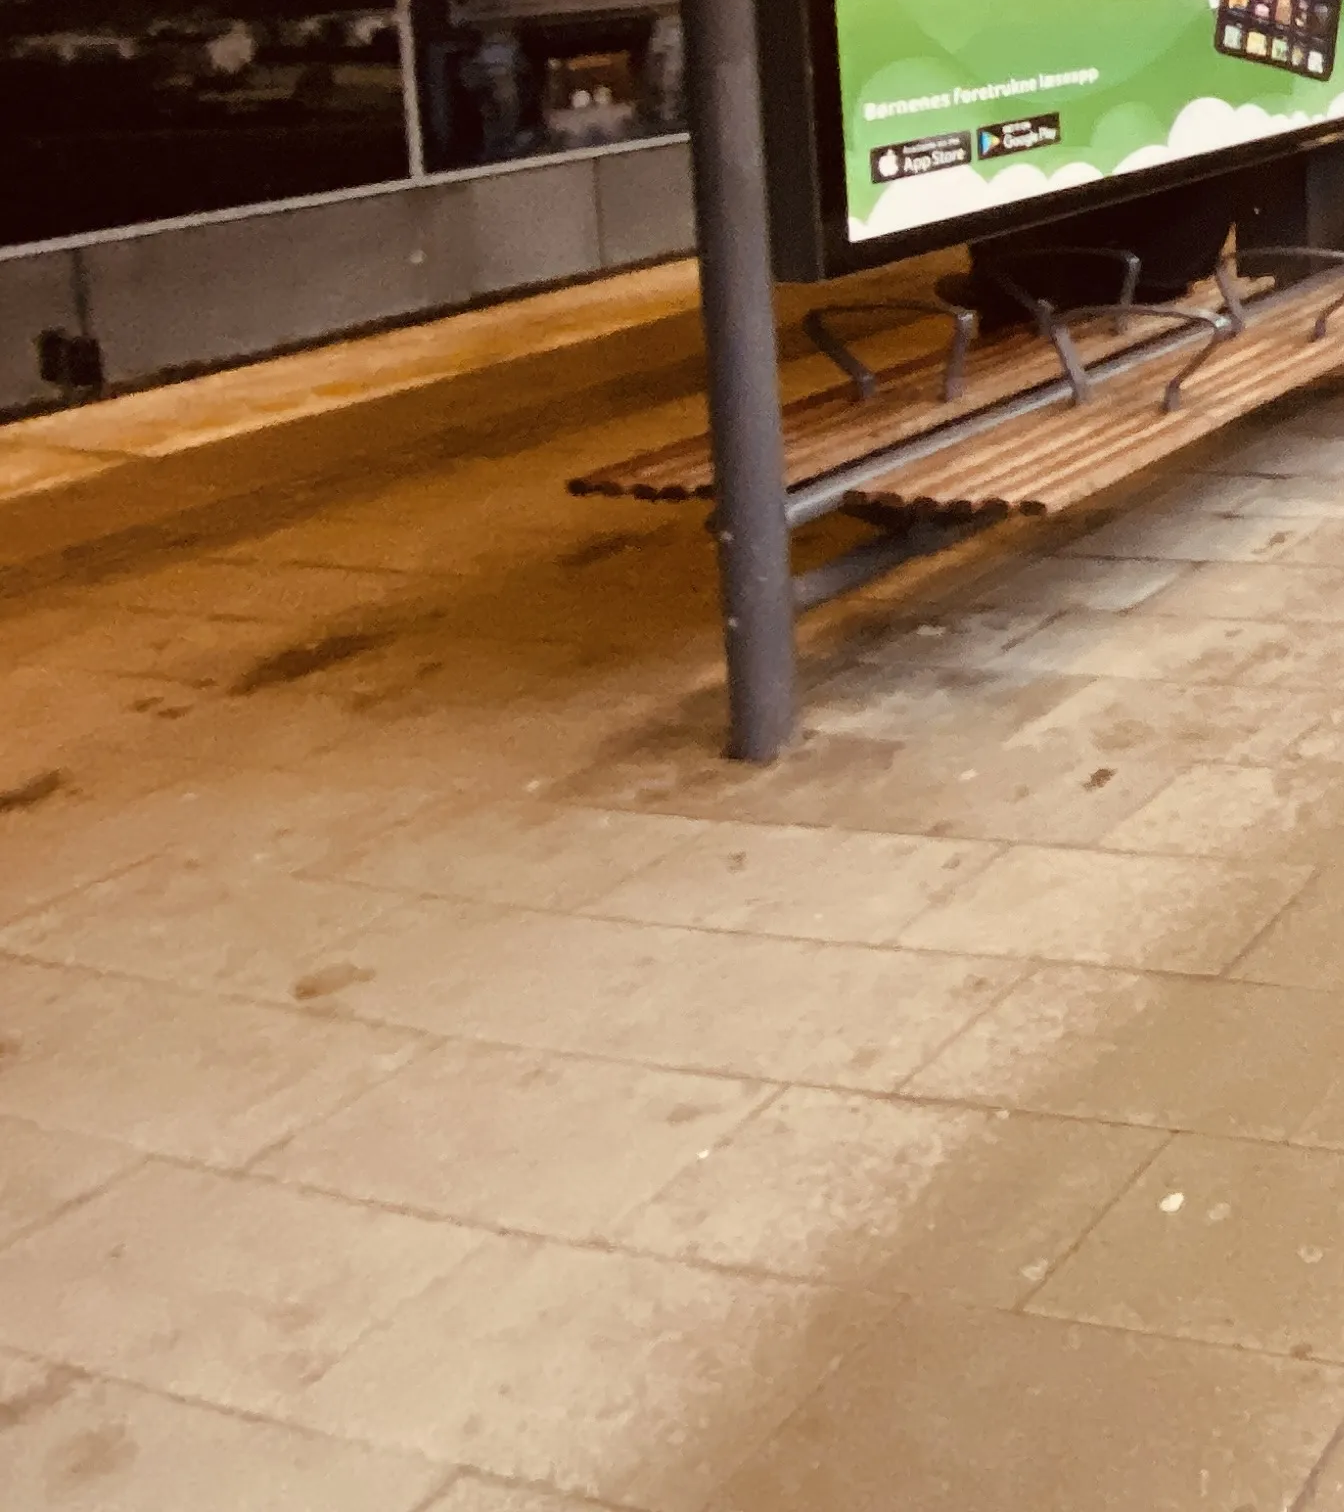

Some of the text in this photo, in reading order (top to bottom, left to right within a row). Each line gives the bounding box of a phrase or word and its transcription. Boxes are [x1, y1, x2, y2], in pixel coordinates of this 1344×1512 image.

[952, 77, 1038, 105] foretrukne
[1003, 131, 1038, 149] Google
[903, 147, 966, 174] App Store
